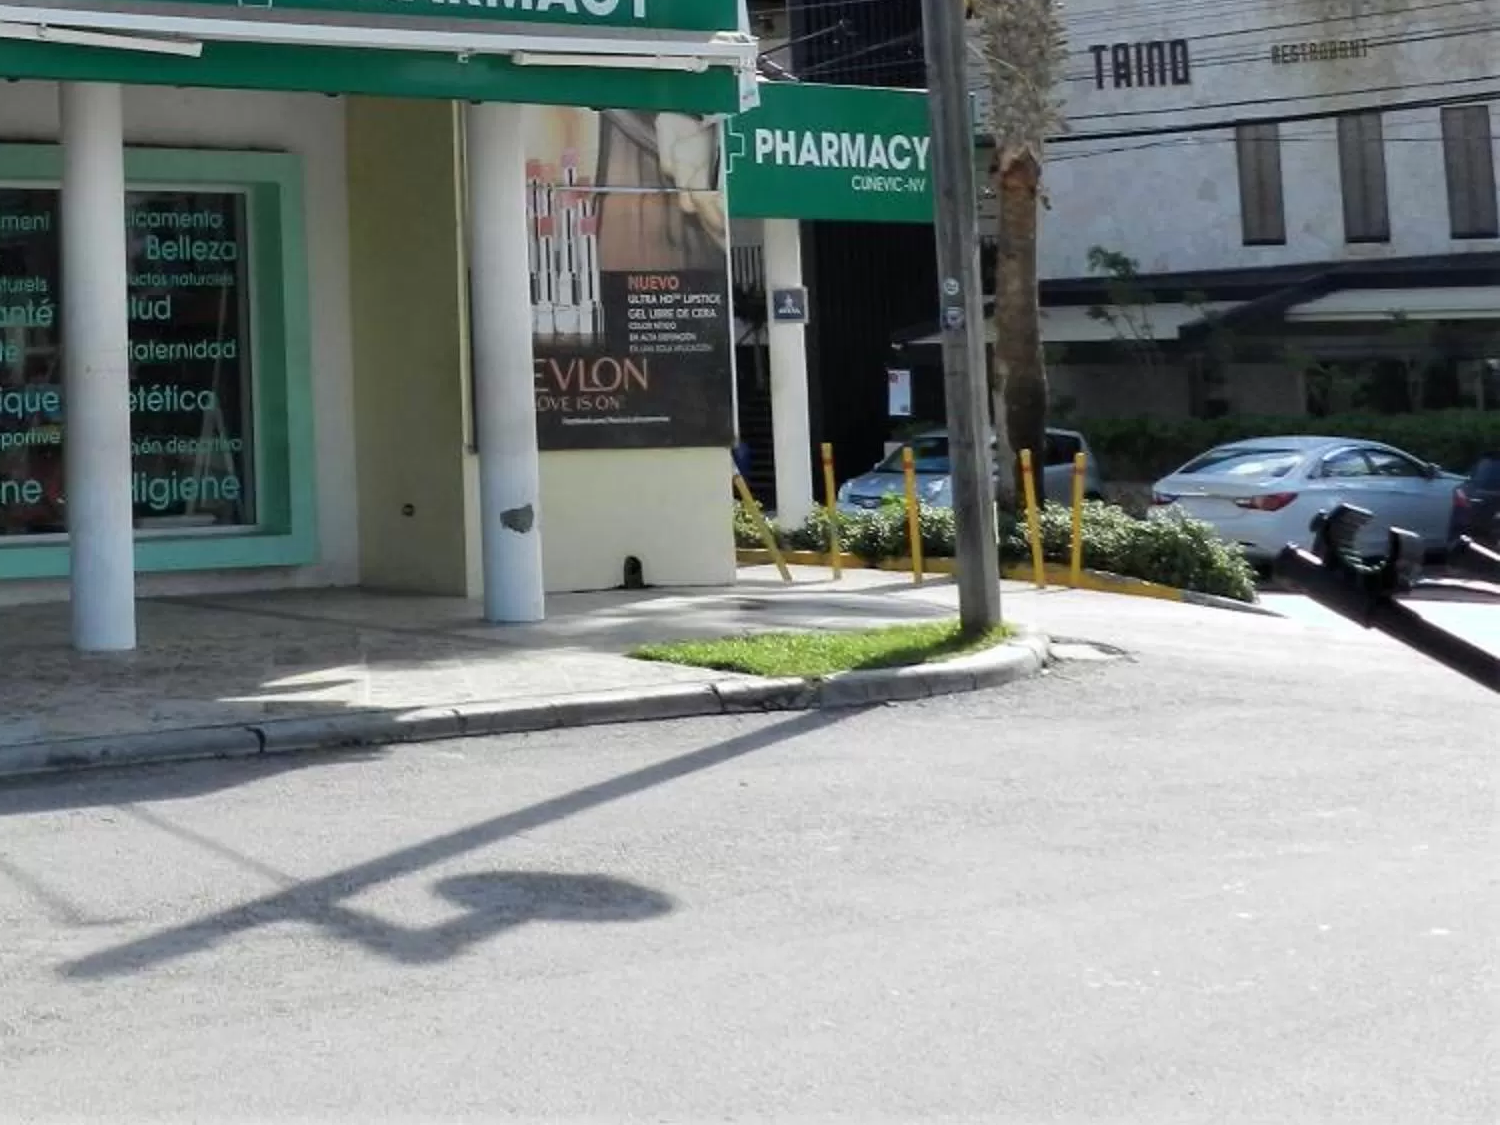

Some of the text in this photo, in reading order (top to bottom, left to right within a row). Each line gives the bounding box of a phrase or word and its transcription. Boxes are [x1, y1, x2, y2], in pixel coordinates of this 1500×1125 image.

[755, 128, 931, 172] PHARMACY
[146, 233, 238, 262] Belleza
[627, 275, 680, 290] NUEVO
[129, 338, 237, 361] aternidad
[534, 356, 648, 391] EVLON
[128, 383, 217, 412] etética
[536, 395, 573, 412] OVE
